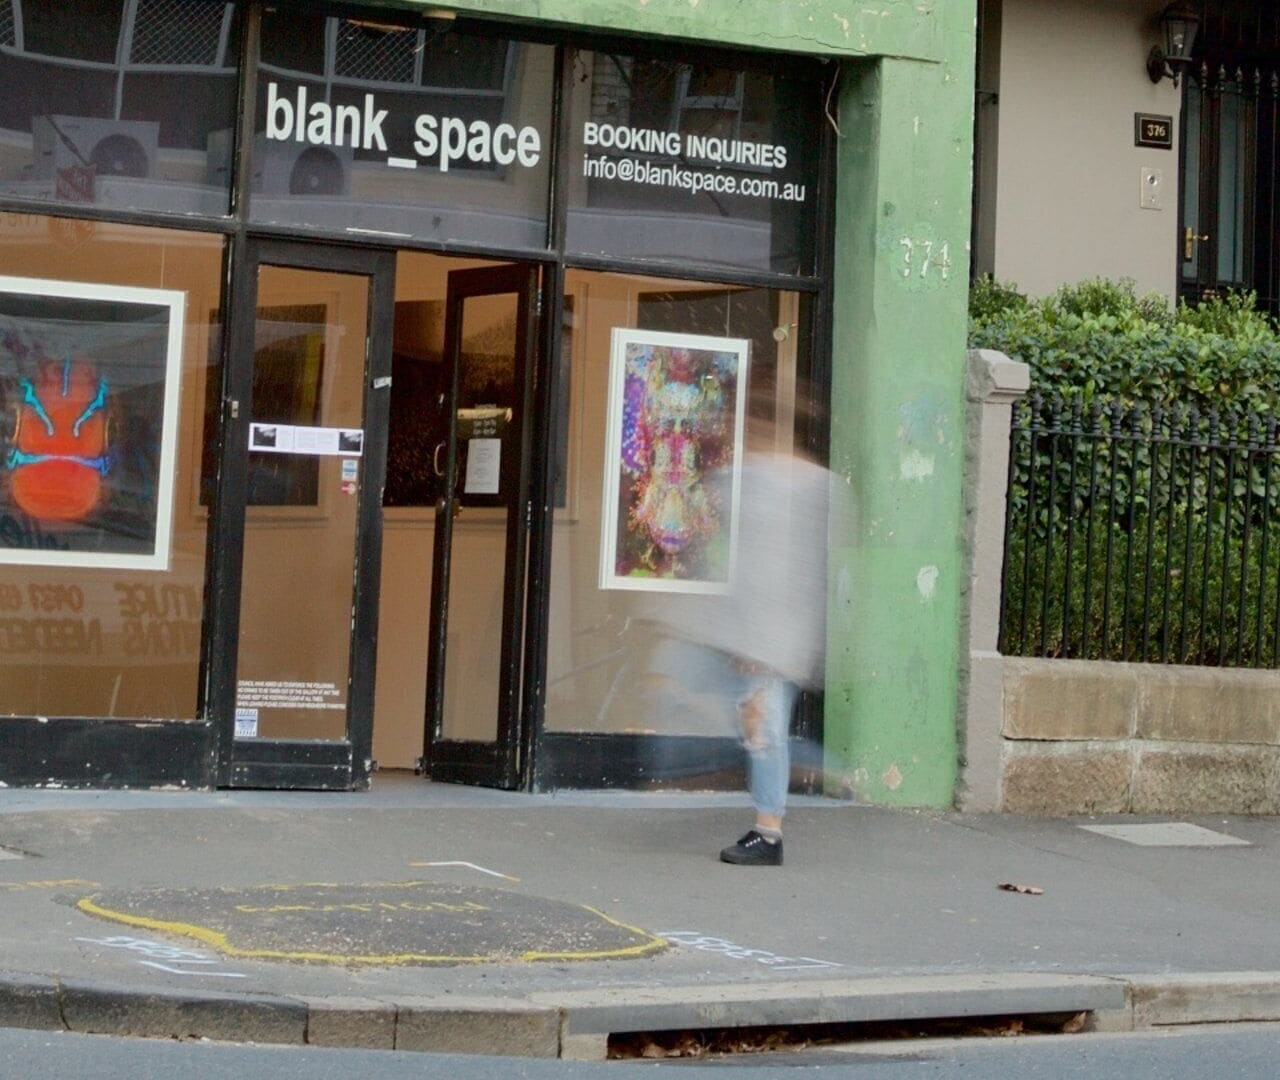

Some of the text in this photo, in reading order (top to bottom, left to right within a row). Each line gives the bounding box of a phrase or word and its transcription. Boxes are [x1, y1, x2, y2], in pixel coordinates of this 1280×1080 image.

[265, 82, 541, 173] blank_space
[583, 121, 787, 169] BOOKING INQUIRIES
[1148, 124, 1166, 137] 376
[583, 152, 806, 202] info@blankspace.com.au
